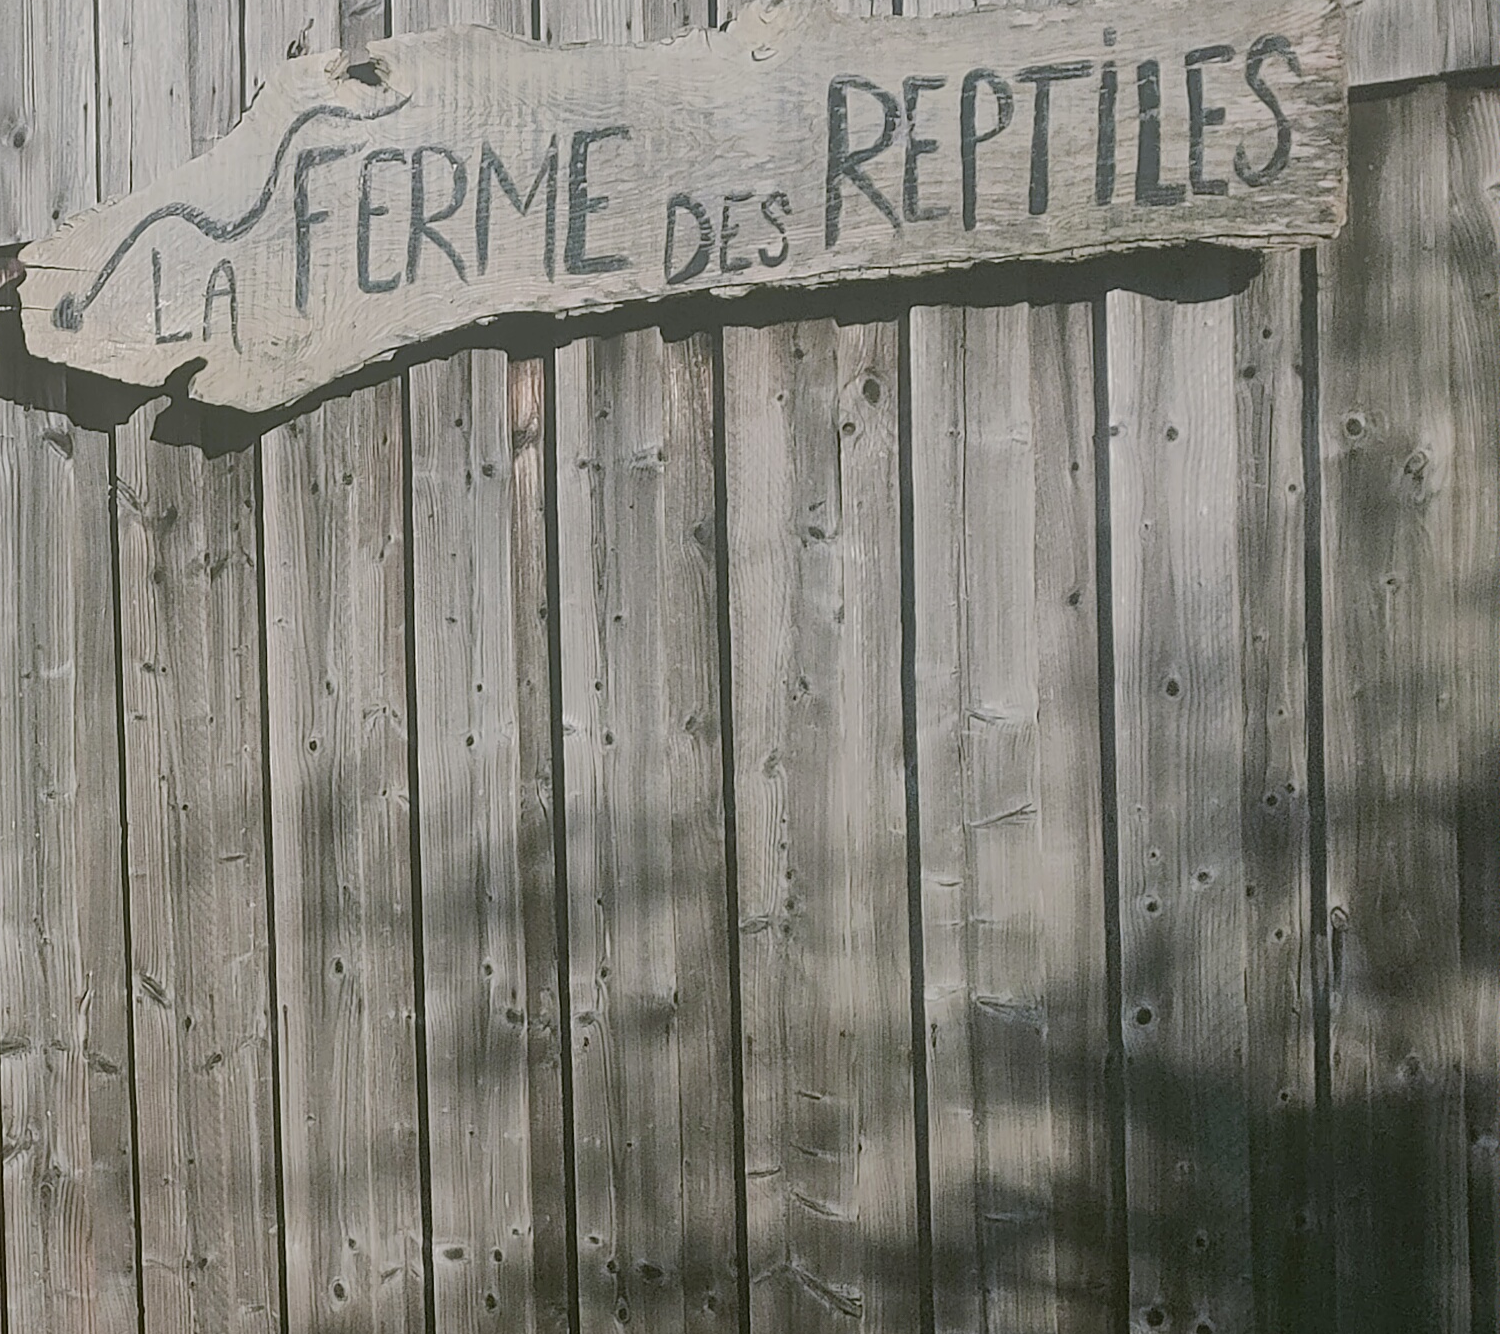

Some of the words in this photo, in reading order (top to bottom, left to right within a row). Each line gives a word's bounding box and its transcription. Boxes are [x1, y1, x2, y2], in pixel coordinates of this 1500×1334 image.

[151, 246, 243, 356] LA
[293, 125, 635, 321] FERME
[663, 191, 793, 285] DES
[824, 28, 1300, 250] REPTILES
